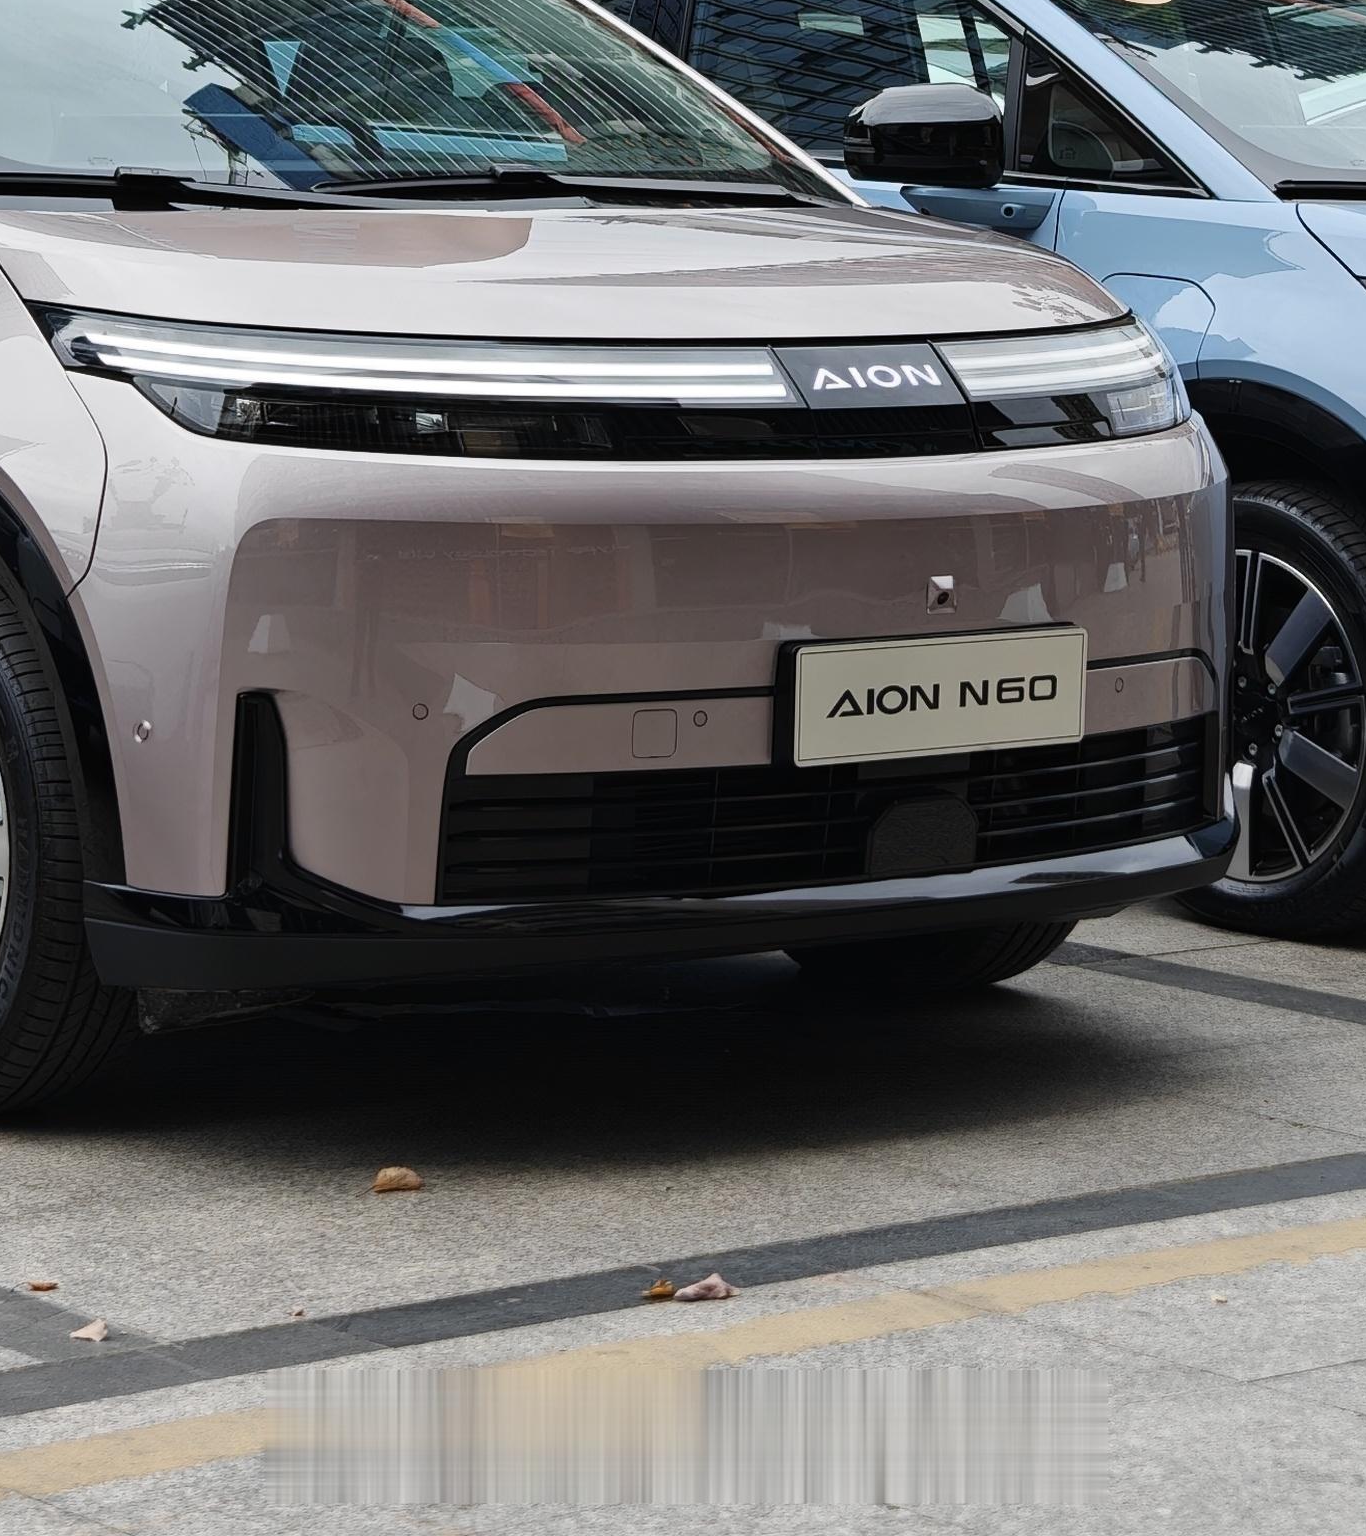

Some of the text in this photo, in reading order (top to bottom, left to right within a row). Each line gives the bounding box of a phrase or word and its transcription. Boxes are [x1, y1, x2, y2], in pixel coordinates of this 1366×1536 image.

[813, 363, 942, 391] AION
[826, 674, 1058, 719] AION N60
